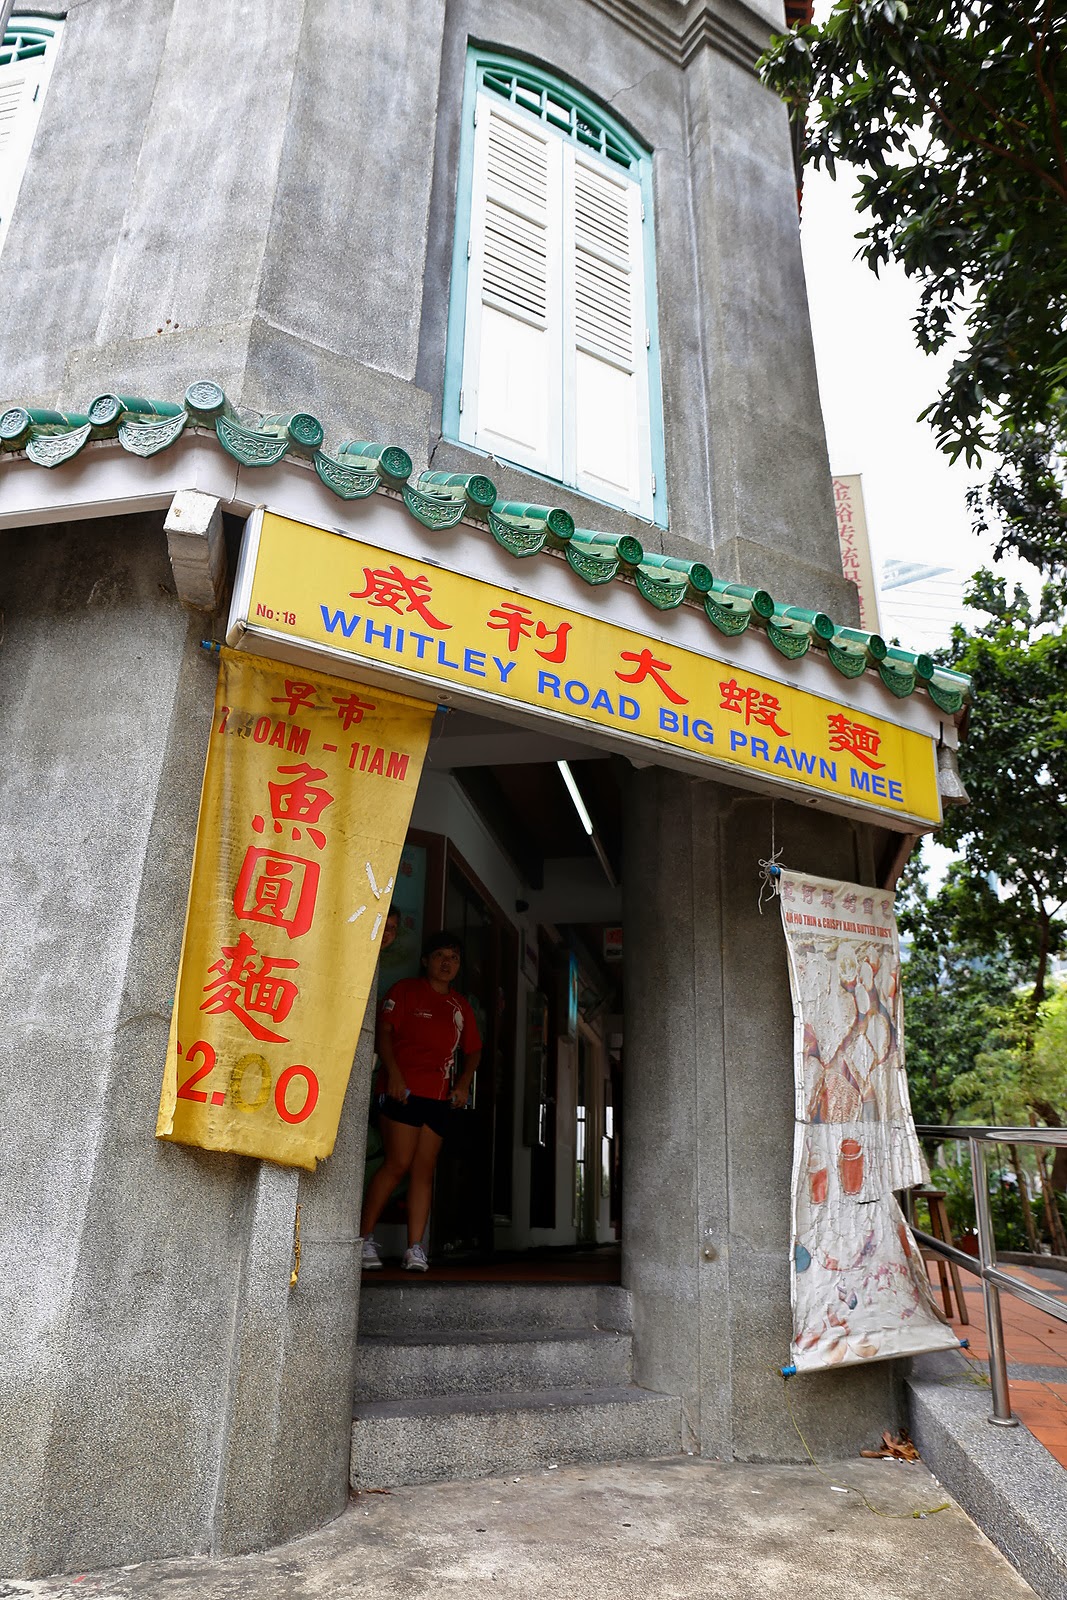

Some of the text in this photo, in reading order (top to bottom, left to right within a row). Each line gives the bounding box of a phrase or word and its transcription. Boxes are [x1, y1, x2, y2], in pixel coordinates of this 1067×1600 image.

[256, 603, 297, 625] No:18
[349, 565, 886, 771] 威利大蝦麵
[271, 680, 377, 732] 早市
[320, 605, 904, 802] WHITLEY ROAD BIG PRAWN MEE
[323, 743, 337, 753] -
[348, 742, 410, 781] 11AM
[199, 762, 335, 1043] 魚圓麵
[803, 914, 817, 927] THIN
[823, 917, 843, 931] CRISPY
[857, 923, 876, 936] BUTTER
[176, 1039, 320, 1126] 2.00
